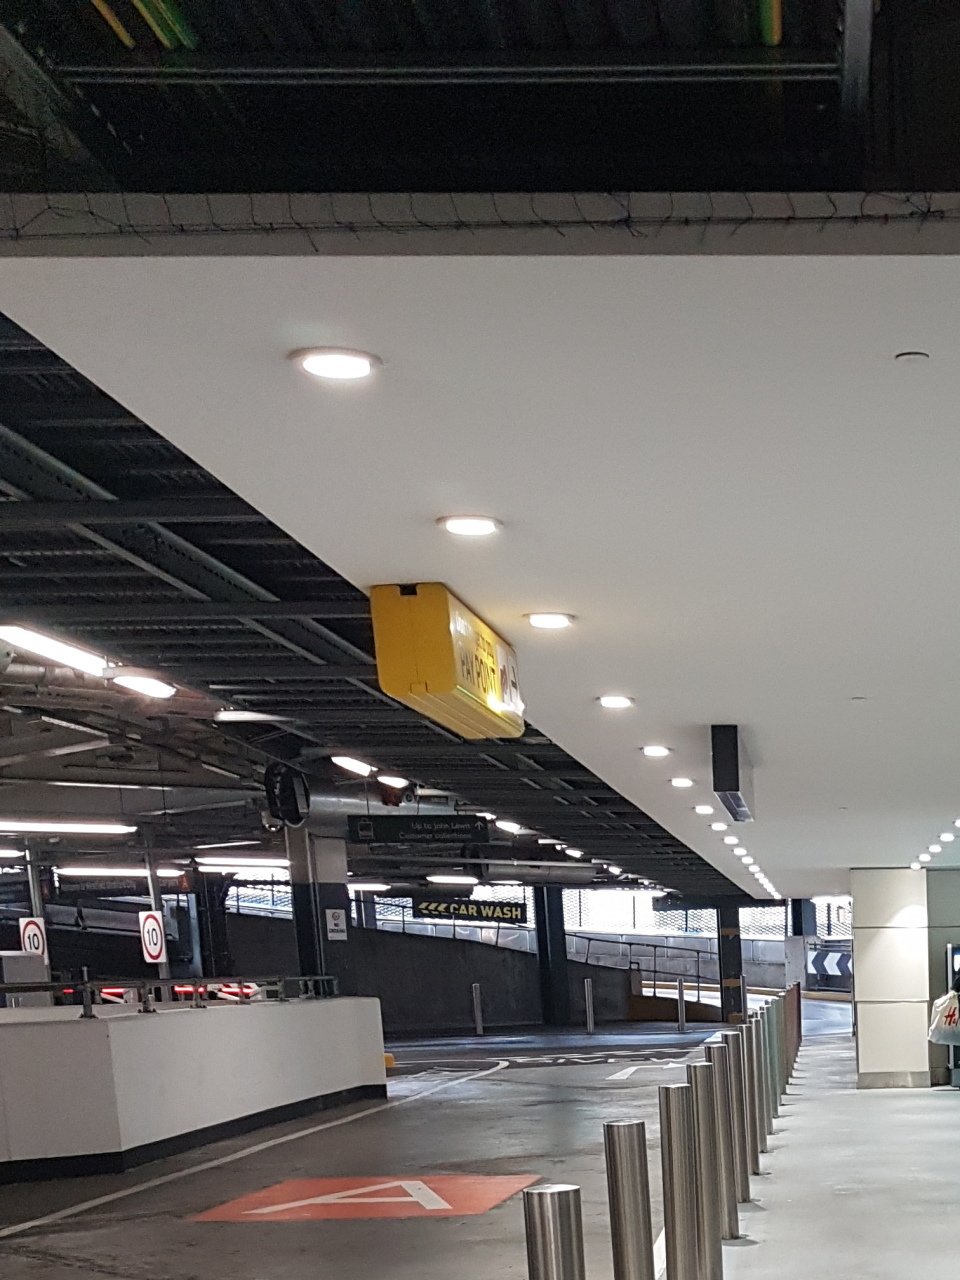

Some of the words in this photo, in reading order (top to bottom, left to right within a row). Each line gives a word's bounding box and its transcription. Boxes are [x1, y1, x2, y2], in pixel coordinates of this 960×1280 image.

[461, 650, 475, 686] PAY
[450, 903, 477, 917] CAR
[480, 904, 522, 919] WASH
[27, 933, 40, 950] 10
[147, 927, 158, 941] 10
[241, 1180, 453, 1215] A
